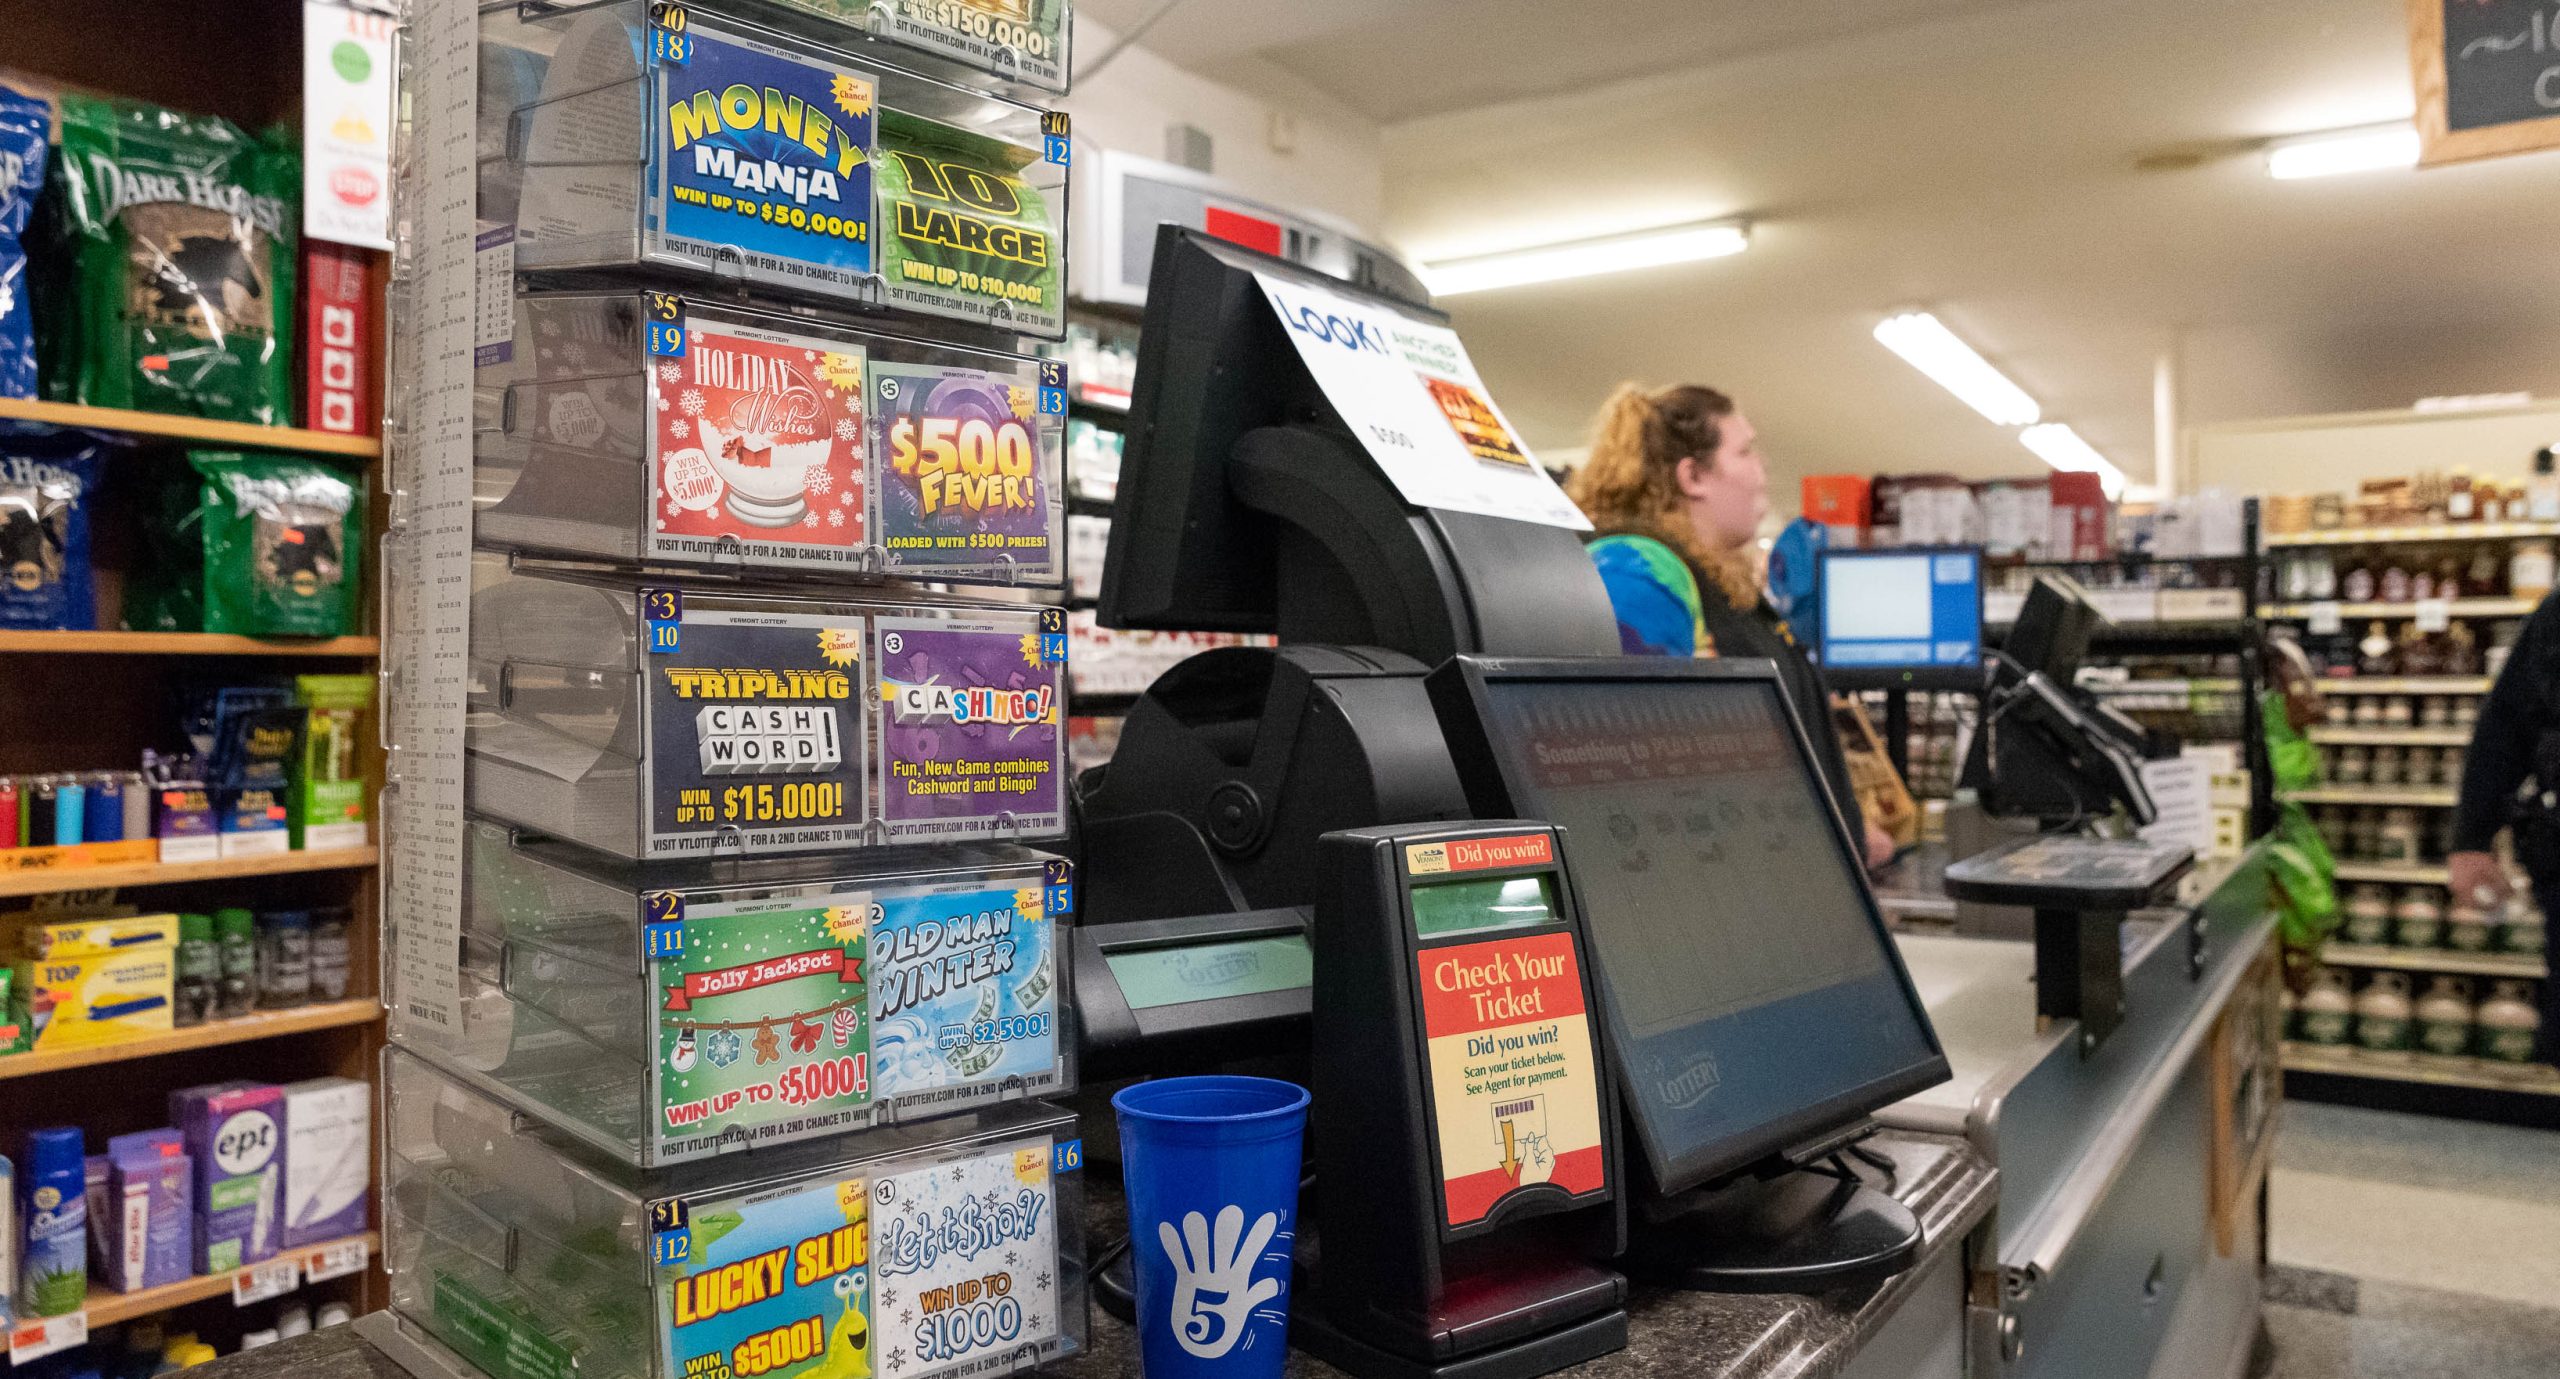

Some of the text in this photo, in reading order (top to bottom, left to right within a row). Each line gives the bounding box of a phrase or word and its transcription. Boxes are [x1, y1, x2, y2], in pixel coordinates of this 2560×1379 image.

[910, 22, 972, 51] VTLOTTERY.COM
[937, 2, 1050, 57] $150,000!
[669, 35, 684, 60] 8
[746, 41, 802, 61] VERMONT LOTTERY
[839, 90, 868, 102] Chance!
[669, 83, 868, 180] MONEY
[1056, 141, 1068, 163] 2
[89, 153, 184, 228] DARK
[891, 150, 1021, 215] 10
[673, 185, 867, 242] WIN UP TO $50,000!
[896, 201, 1047, 267] LARGE
[665, 238, 838, 283] VISIT CHANCE
[902, 259, 1043, 305] WIN UP TO $10,000!
[654, 294, 680, 320] $5
[905, 289, 963, 311] VTLOTTERY.COM
[733, 329, 790, 344] VERMONT LOTTERY
[1274, 294, 1390, 355] LOOK!
[665, 327, 681, 353] 9
[693, 346, 792, 396] HOLIDAY
[829, 365, 859, 376] Chance!
[1041, 363, 1060, 386] $5
[881, 382, 897, 396] $5
[729, 385, 820, 436] Wishes
[1051, 391, 1063, 413] 3
[890, 417, 1032, 480] $500
[674, 469, 690, 482] UP
[676, 456, 700, 470] WIN
[672, 475, 718, 501] $5,000!
[920, 467, 1036, 514] FEVER!
[656, 539, 833, 562] VISIT CHANCE
[887, 533, 1047, 548] LOADED WITH $500 PRIZES!
[651, 592, 676, 619] $3
[1043, 610, 1061, 631] $3
[656, 626, 678, 647] 10
[827, 640, 856, 650] Chance!
[886, 638, 900, 650] $3
[1052, 638, 1065, 659] 4
[665, 667, 850, 699] TRIPLING
[906, 687, 1051, 721] CASHINGO!
[713, 710, 811, 730] CASH
[1534, 740, 1631, 765] Something
[892, 757, 1049, 777] Fun, New Game combines
[681, 790, 711, 805] WIN
[908, 776, 1037, 795] Cashword and Bingo!
[677, 806, 714, 823] UP TO
[723, 782, 842, 822] $15,000!
[905, 819, 963, 835] VTLOTTERY.COM
[653, 831, 830, 851] VISIT CHANCE
[1455, 840, 1545, 866] Did you win?
[1414, 853, 1443, 865] VERMONT
[1048, 862, 1067, 884] $2
[735, 902, 792, 913] VERMONT LOTTERY
[1057, 889, 1068, 911] 5
[57, 929, 83, 942] TOP
[832, 916, 863, 930] Chance!
[663, 930, 684, 951] 11
[872, 909, 1012, 964] OLD MAN
[45, 965, 81, 984] TOP
[698, 952, 832, 993] Jolly JackPot
[875, 941, 1015, 1021] WINTER
[1434, 952, 1565, 992] Check Your
[1470, 986, 1544, 1023] Ticket
[942, 1026, 965, 1036] WIN
[974, 1013, 1049, 1044] $2,500!
[1467, 1025, 1558, 1057] Did you win?
[1464, 1051, 1565, 1079] Scan your ticket below.
[666, 1053, 867, 1127] WIN UP TO $5,000!
[1466, 1067, 1567, 1096] See Agent for payment.
[218, 1122, 270, 1161] ept
[661, 1114, 839, 1157] VISIT CHANCE
[937, 1151, 986, 1164] VERMONT LOTTERY
[1019, 1159, 1044, 1173] Chance!
[1066, 1144, 1078, 1167] 6
[745, 1186, 803, 1204] VERMONT LOTTERY
[656, 1200, 681, 1227] $1
[667, 1236, 688, 1260] 12
[879, 1211, 937, 1277] Let
[937, 1206, 959, 1254] it
[674, 1245, 790, 1327] LUCKY
[920, 1272, 1012, 1315] WIN UP TO
[915, 1296, 1021, 1362] $1,000
[1185, 1288, 1229, 1345] 5
[732, 1315, 826, 1377] $500!
[1041, 1340, 1057, 1354] WIN!
[685, 1352, 722, 1374] WIN
